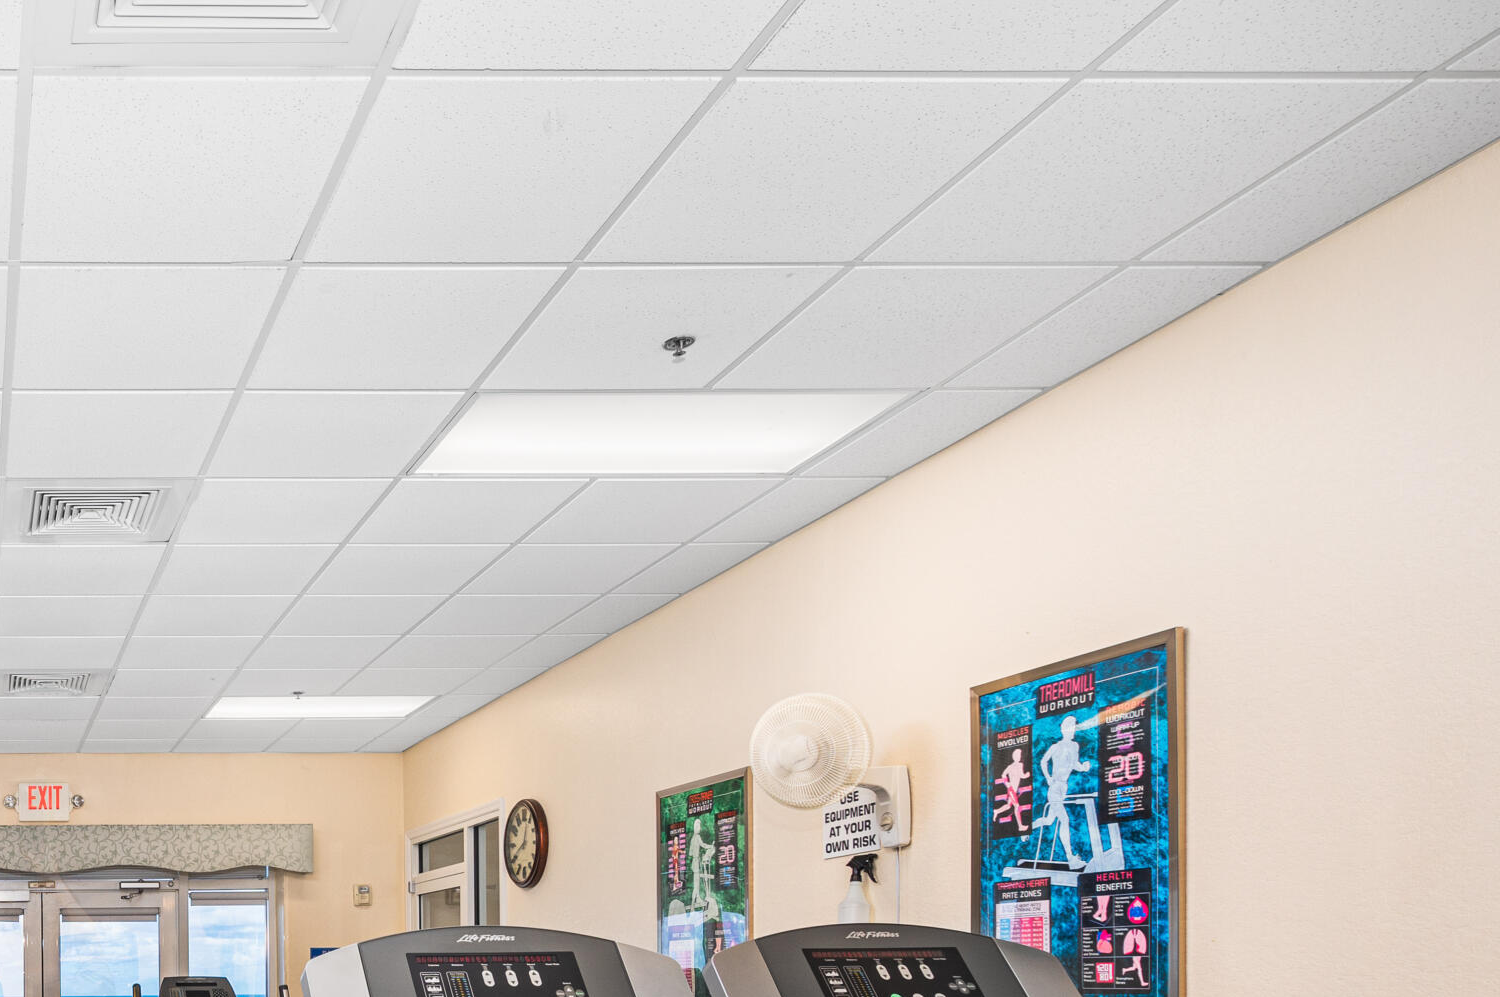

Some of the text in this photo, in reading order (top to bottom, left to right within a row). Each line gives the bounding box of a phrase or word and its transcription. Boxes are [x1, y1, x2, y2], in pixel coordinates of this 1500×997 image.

[1039, 673, 1095, 703] TREADMILL
[1039, 693, 1094, 714] WORKOUT
[997, 726, 1029, 740] MUSCLES
[997, 735, 1029, 748] INVOLVED
[1108, 752, 1144, 783] 20
[28, 785, 63, 810] EXIT
[840, 790, 859, 805] USE
[824, 802, 876, 824] EQUIPMENT
[829, 820, 871, 838] AT YOUR
[825, 834, 876, 853] OWN RISK
[1026, 878, 1049, 888] HEART
[1096, 871, 1133, 882] HEALTH
[1002, 890, 1042, 899] RATE ZONES
[1096, 882, 1133, 892] BENEFITS
